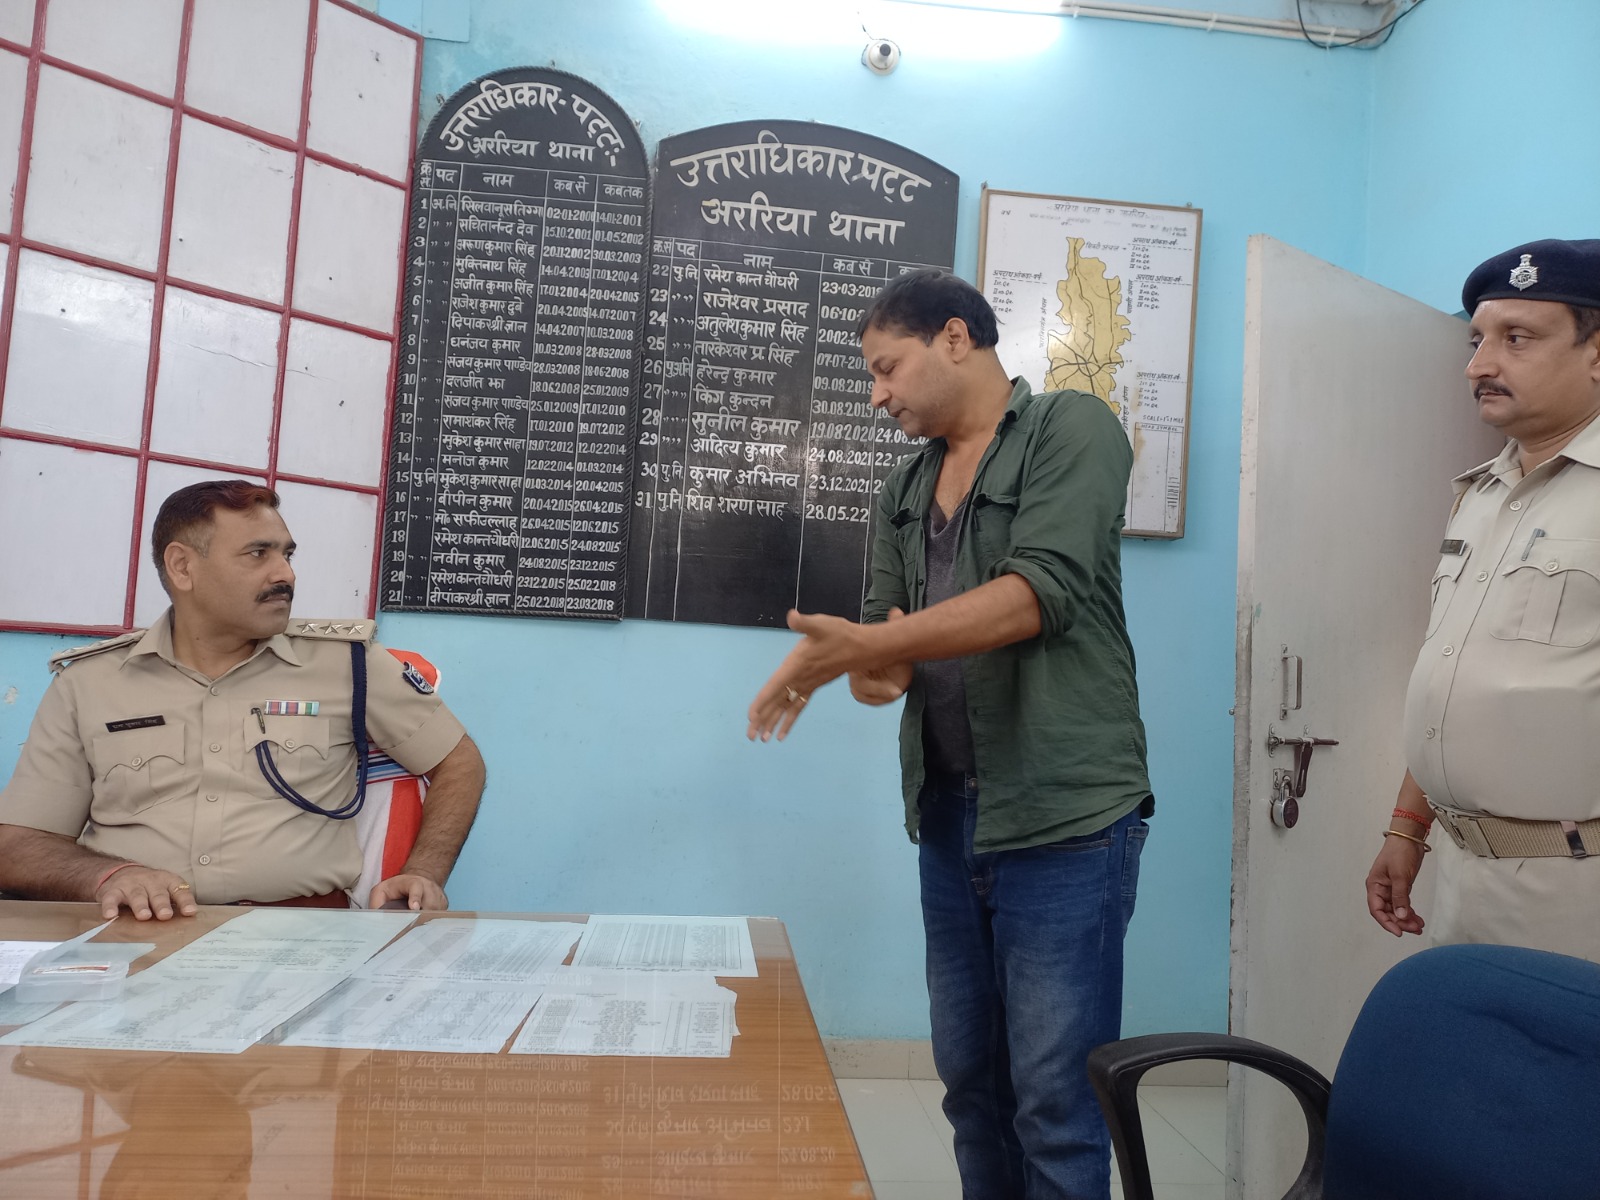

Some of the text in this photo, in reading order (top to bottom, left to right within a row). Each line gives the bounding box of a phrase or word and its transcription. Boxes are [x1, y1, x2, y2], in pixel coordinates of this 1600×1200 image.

[468, 130, 596, 162] अररिया थाना
[436, 168, 514, 187] पद नाम
[421, 199, 428, 209] 1
[418, 217, 426, 228] 2
[516, 219, 537, 236] देव
[701, 191, 905, 245] अररिया थाना
[414, 236, 425, 247] 3
[515, 239, 537, 259] सिंह
[413, 256, 425, 267] 4
[508, 257, 527, 277] सिंह
[675, 242, 874, 276] पद नाम कब से
[413, 273, 534, 298] 5 अजीत कुमार सिंह
[652, 264, 669, 277] 22
[703, 264, 734, 284] रमेश
[736, 271, 763, 286] कान्त
[412, 294, 421, 306] 6
[452, 293, 478, 310] राजेश
[479, 300, 507, 313] कुमार
[508, 296, 524, 314] दुबे
[650, 287, 810, 318] 23 राजेश्वर प्रसाद
[411, 314, 419, 325] 7
[649, 310, 809, 345] 24 सिंह
[407, 334, 416, 345] 8
[450, 333, 489, 350] धनंजय
[492, 338, 521, 354] कुमार
[647, 336, 665, 351] 25
[695, 338, 748, 360] तारकेश्वर
[768, 342, 800, 367] सिंह
[407, 354, 501, 373] 9 संजय कुमार
[644, 359, 663, 375] 26
[697, 358, 732, 384] हरेन्द्र
[732, 368, 777, 386] कुमार
[403, 373, 416, 385] 10
[445, 371, 484, 389] दलजीत
[488, 377, 505, 390] झा
[402, 393, 413, 405] 11
[444, 391, 472, 407] संजय
[472, 396, 499, 411] कुमार
[644, 383, 662, 399] 27
[730, 391, 775, 411] कुन्दन
[401, 413, 413, 424] 12
[493, 412, 516, 433] सिंह
[641, 407, 660, 426] 28
[692, 406, 748, 436] सुनील
[750, 417, 802, 441] कुमार
[399, 432, 412, 443] 13
[442, 430, 473, 451] मुकेश
[474, 435, 501, 452] कुमार
[639, 431, 871, 466] 29 आदित्य कुमार 24.08.2021
[397, 452, 410, 464] 14
[441, 451, 477, 466] मनोज
[478, 456, 509, 470] कुमार
[396, 471, 409, 483] 15
[439, 468, 469, 488] मुकेश
[470, 474, 498, 490] कुमार
[641, 461, 869, 493] 30 कुमार अभिनव 23.12.2021
[395, 489, 513, 511] 16 बीपीन कुमार
[635, 487, 869, 523] 31 शिव शरण साह 28.05.22
[393, 511, 406, 522] 17
[391, 530, 405, 543] 18
[435, 527, 462, 547] रमेश
[392, 550, 405, 562] 19
[433, 547, 470, 566] नवीन
[473, 554, 505, 571] कुमार
[391, 571, 404, 582] 20
[431, 569, 457, 586] रमेश
[389, 590, 401, 602] 21
